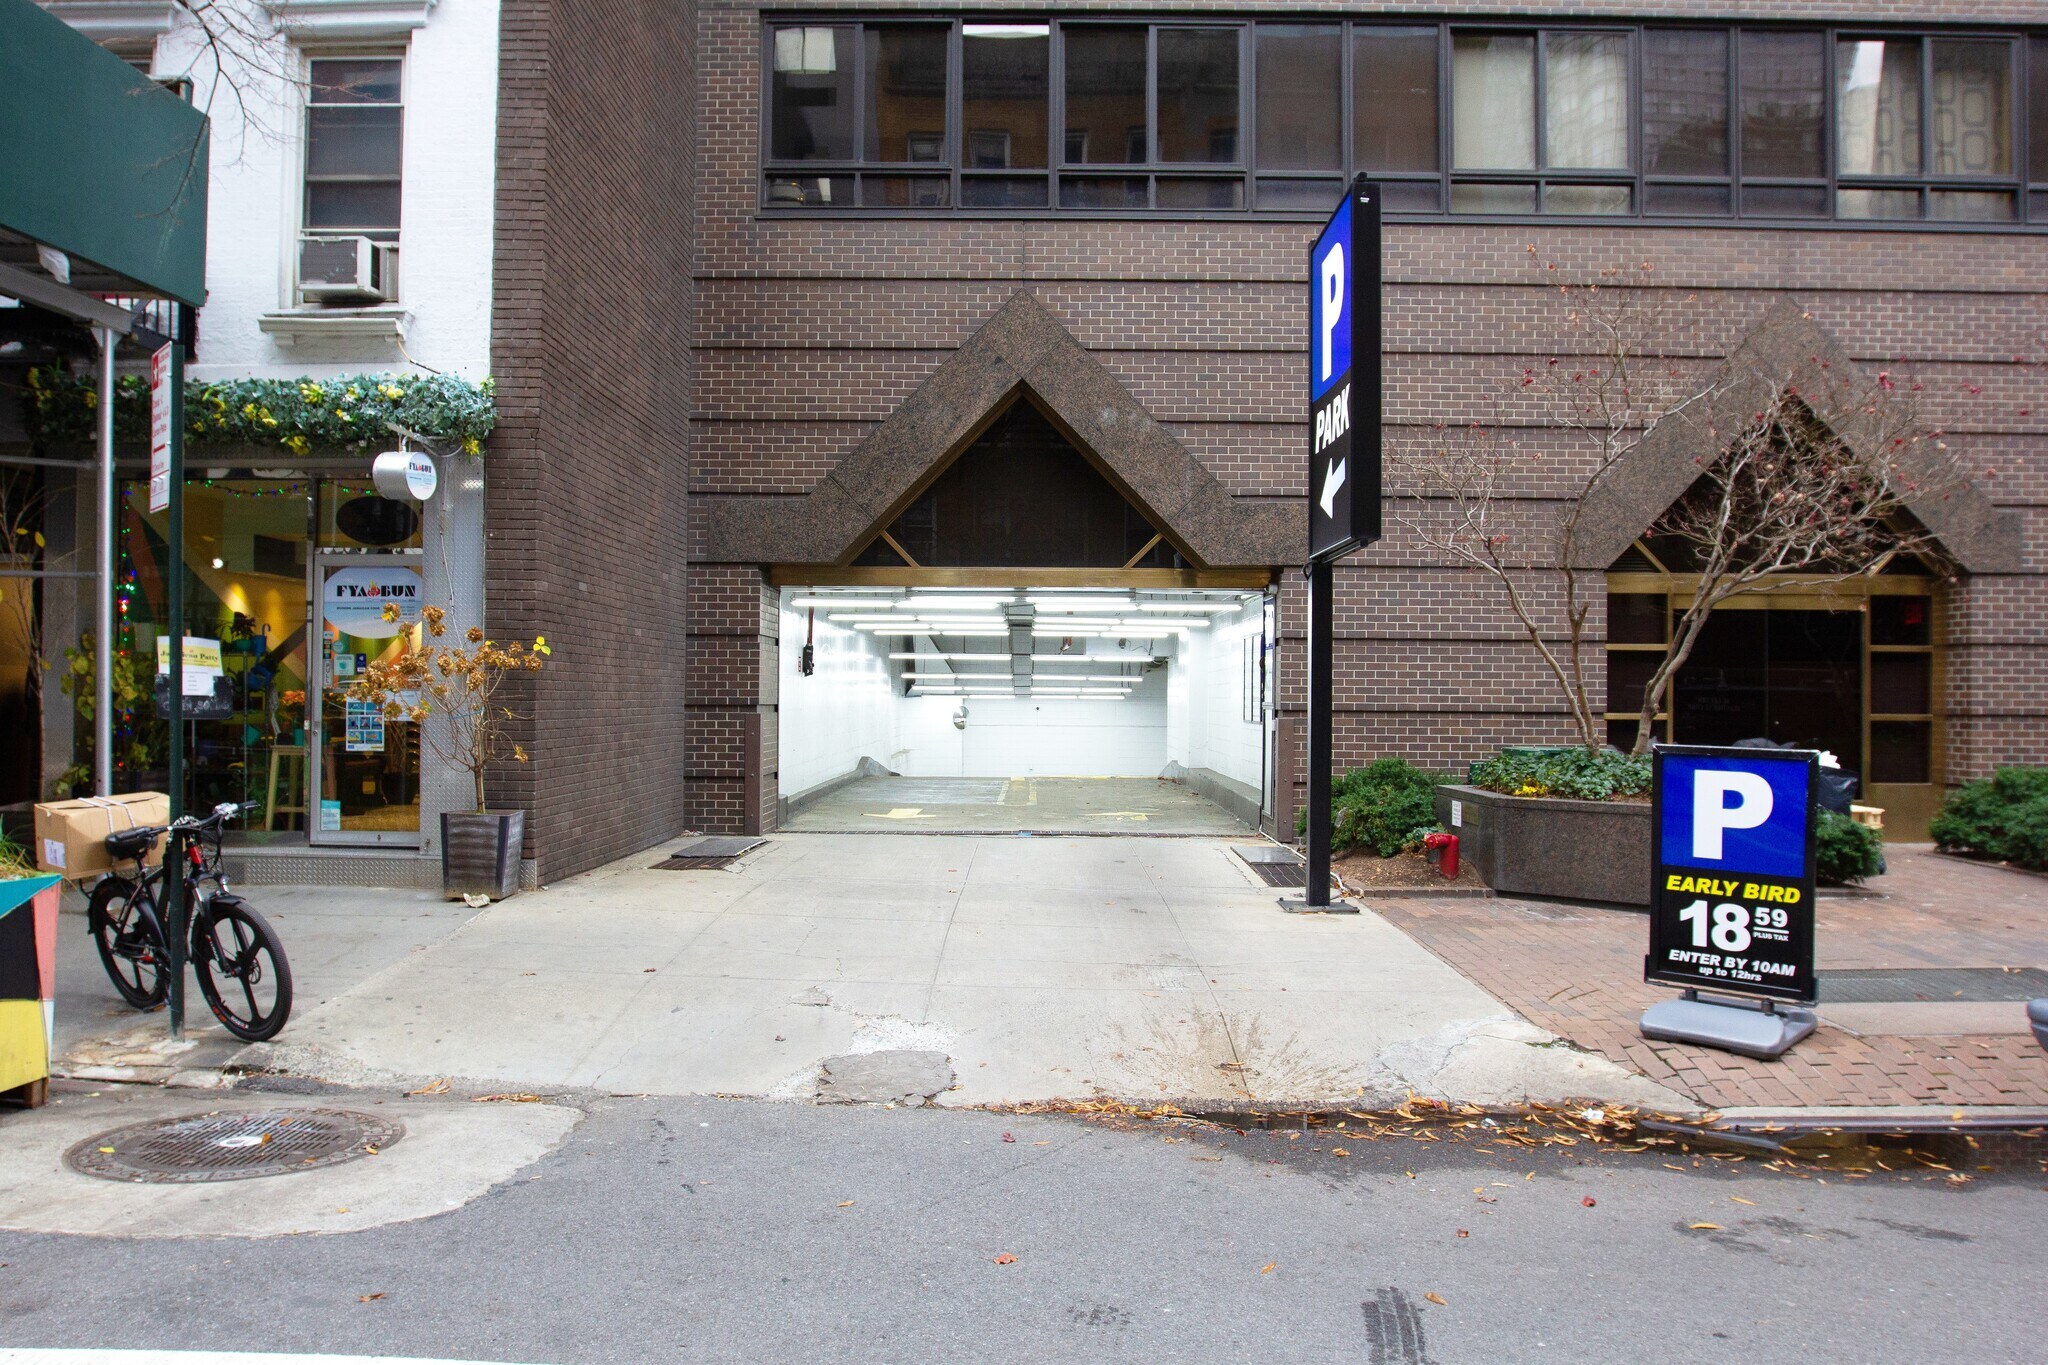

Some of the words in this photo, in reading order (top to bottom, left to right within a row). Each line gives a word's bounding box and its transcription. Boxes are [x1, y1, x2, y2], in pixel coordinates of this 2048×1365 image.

[1321, 242, 1345, 383] P
[1314, 382, 1351, 455] PARK
[336, 585, 367, 597] FYA
[380, 585, 416, 597] BUN
[1692, 769, 1774, 860] P
[1666, 874, 1740, 897] EARLY
[1743, 882, 1801, 904] BIRD
[1679, 899, 1752, 952] 18
[1754, 906, 1788, 928] 59
[1753, 931, 1773, 940] PLUS
[1773, 933, 1789, 942] TAX
[1668, 949, 1721, 967] ENTER
[1723, 956, 1748, 970] BY
[1751, 960, 1797, 977] 10AM
[1699, 966, 1714, 976] up
[1715, 968, 1728, 977] to
[1730, 969, 1762, 982] 12hrs
